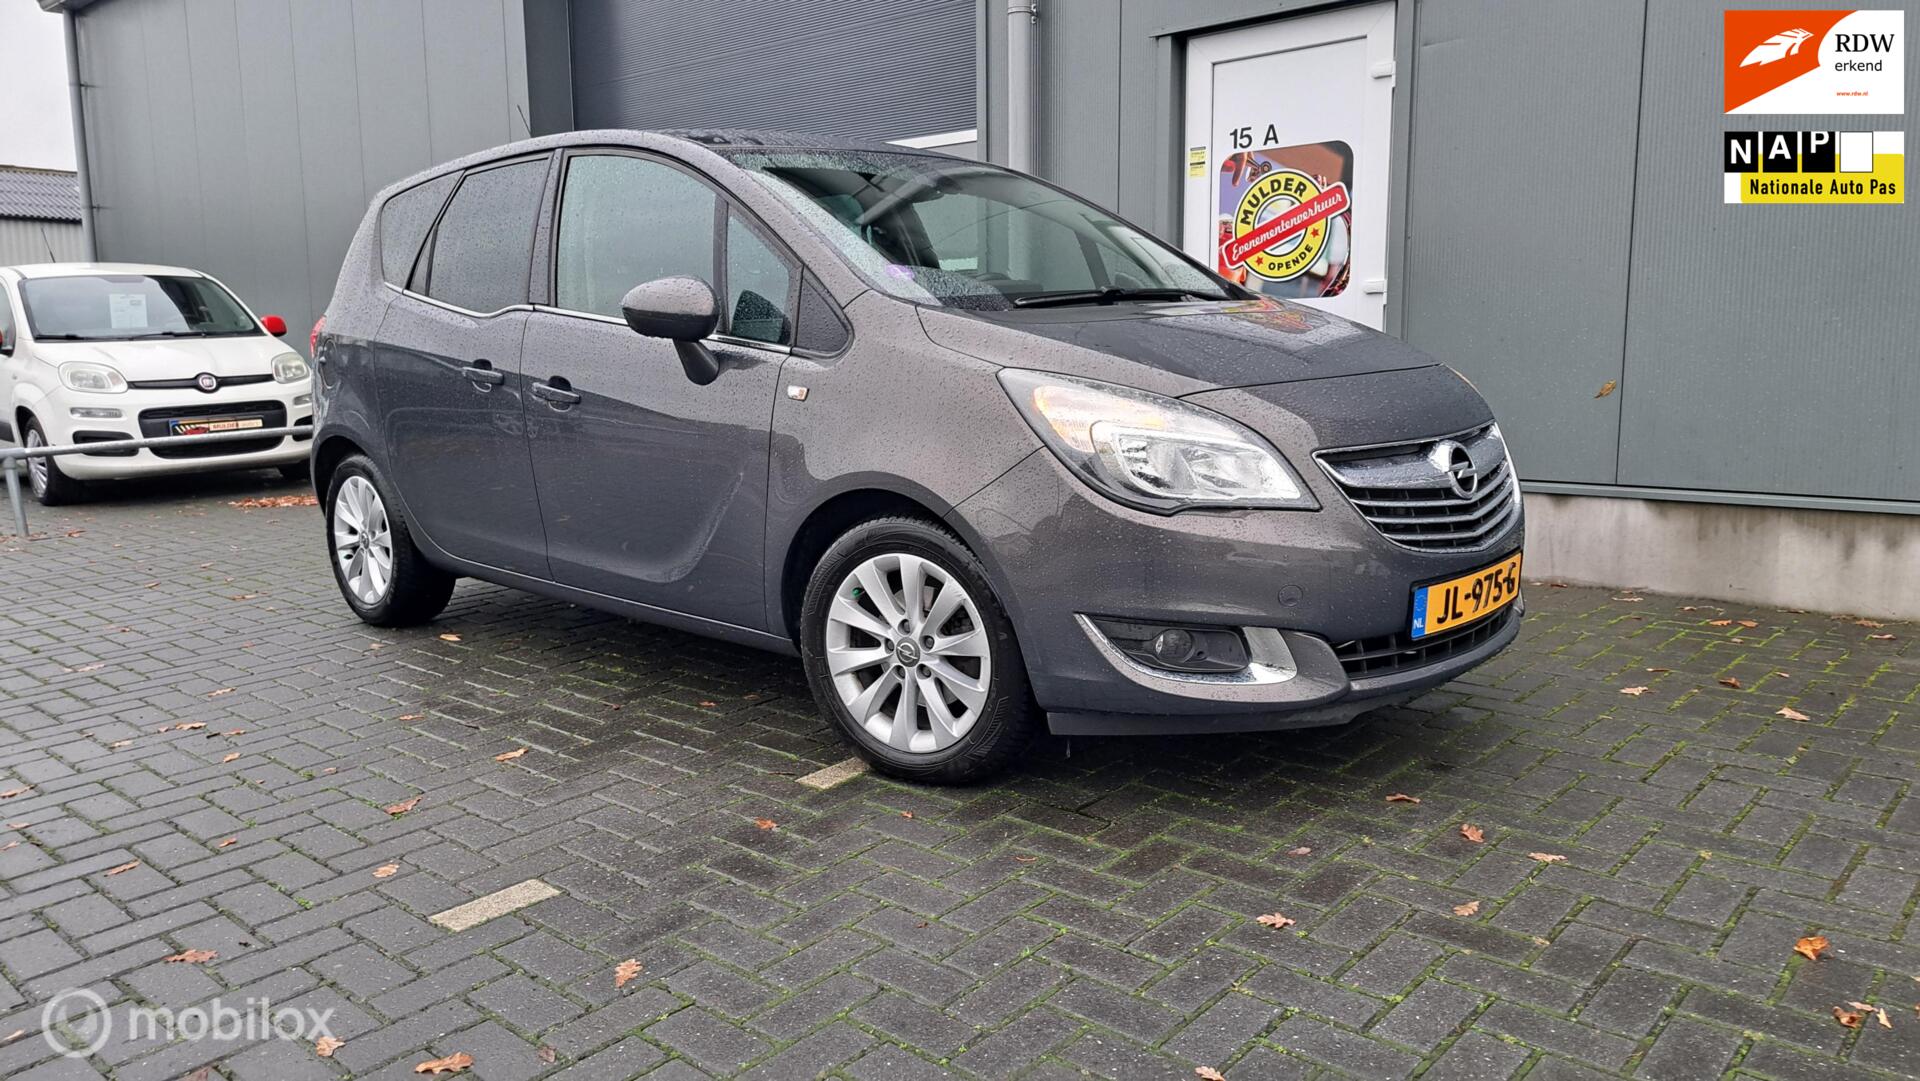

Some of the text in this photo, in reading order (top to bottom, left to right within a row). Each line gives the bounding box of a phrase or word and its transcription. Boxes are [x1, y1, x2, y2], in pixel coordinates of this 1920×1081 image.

[1229, 124, 1279, 149] 15 A
[1240, 177, 1307, 226] MULDER
[1232, 192, 1342, 261] Evenementenverhuur
[1268, 244, 1313, 271] OPENDE
[1412, 617, 1425, 630] NL
